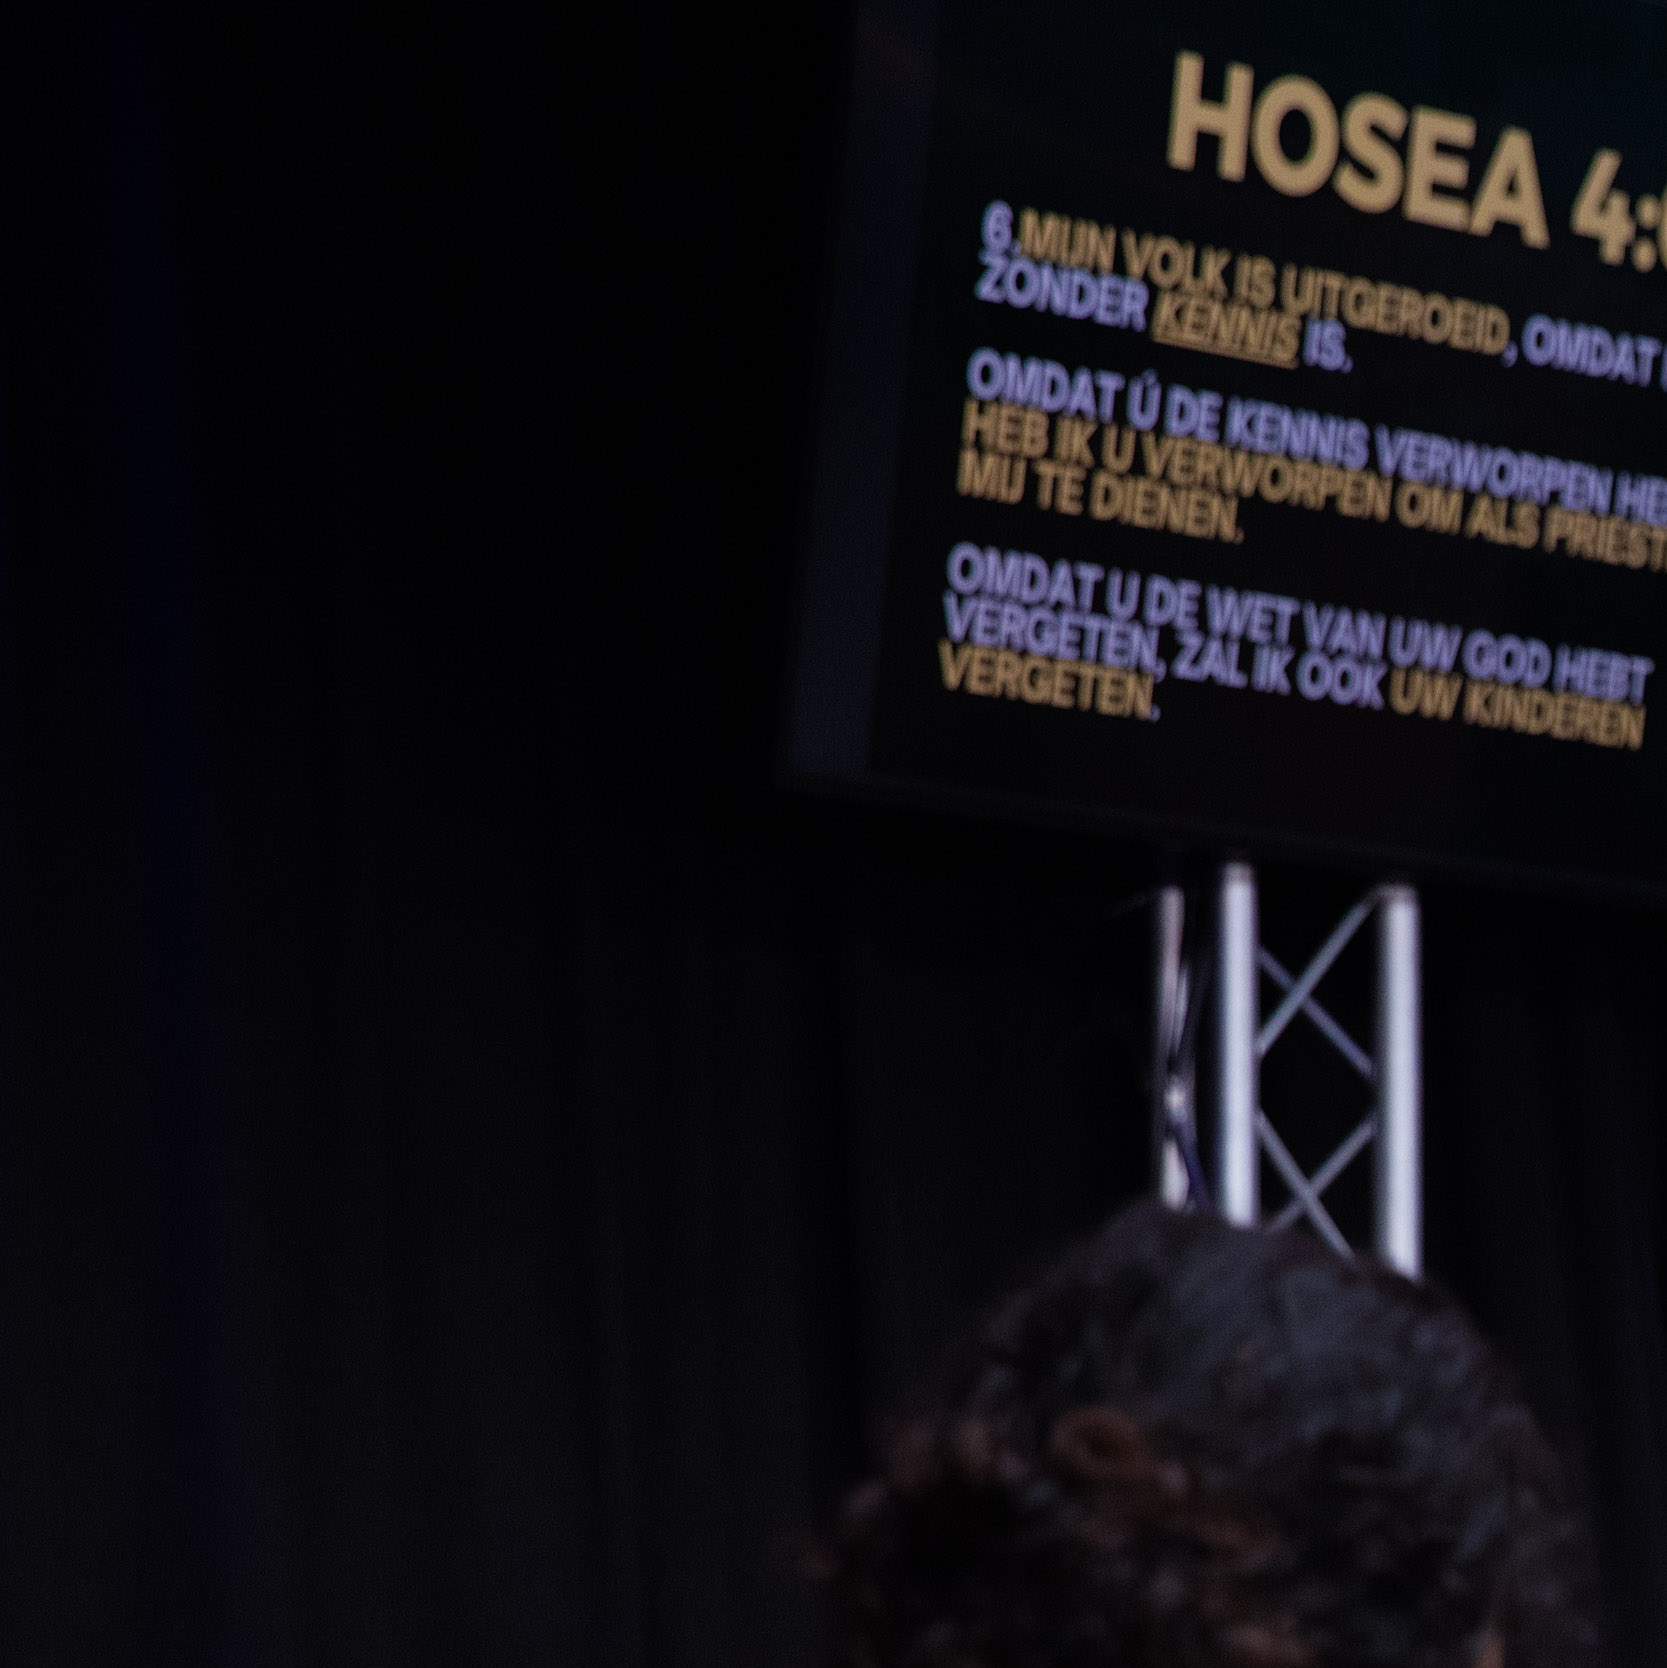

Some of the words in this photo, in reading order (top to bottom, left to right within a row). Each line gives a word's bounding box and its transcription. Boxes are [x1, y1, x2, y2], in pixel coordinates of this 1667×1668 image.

[1166, 48, 1551, 251] HOSEA
[974, 250, 1150, 332] ZONDER
[1151, 291, 1301, 370] KENNIS
[1302, 317, 1354, 374] IS.
[1121, 224, 1232, 300] VOLK
[1233, 251, 1277, 310] IS
[1280, 261, 1519, 368] UITGEROEID,
[1521, 312, 1662, 388] OMDAT
[955, 447, 1028, 505] MIJ
[1032, 459, 1087, 517] TE
[1088, 467, 1246, 545] DIENEN.
[960, 395, 1049, 459] HEB
[1053, 414, 1099, 469] IK
[1102, 423, 1137, 475] U
[1141, 428, 1395, 524] VERWORPEN
[1396, 478, 1464, 536] OM
[1464, 493, 1541, 550] ALS
[965, 346, 1125, 423] OMDAT
[1163, 383, 1224, 442] DE
[1224, 394, 1370, 469] KENNIS
[1374, 422, 1616, 516] VERWORPEN
[936, 636, 1162, 723] VERGETEN.
[942, 587, 1168, 684] VERGETEN,
[1169, 627, 1249, 690] ZAL
[1249, 642, 1297, 696] IK
[1296, 649, 1388, 711] OOK
[1389, 665, 1464, 723] UW
[1462, 676, 1647, 752] KINDEREN
[945, 540, 1105, 615] OMDAT
[1104, 566, 1142, 622] U
[1142, 572, 1203, 631] DE
[1203, 582, 1302, 647] WET
[1301, 598, 1387, 662] VAN
[1387, 613, 1464, 673] UW
[1461, 627, 1552, 688] GOD
[1552, 641, 1656, 707] HEBT
